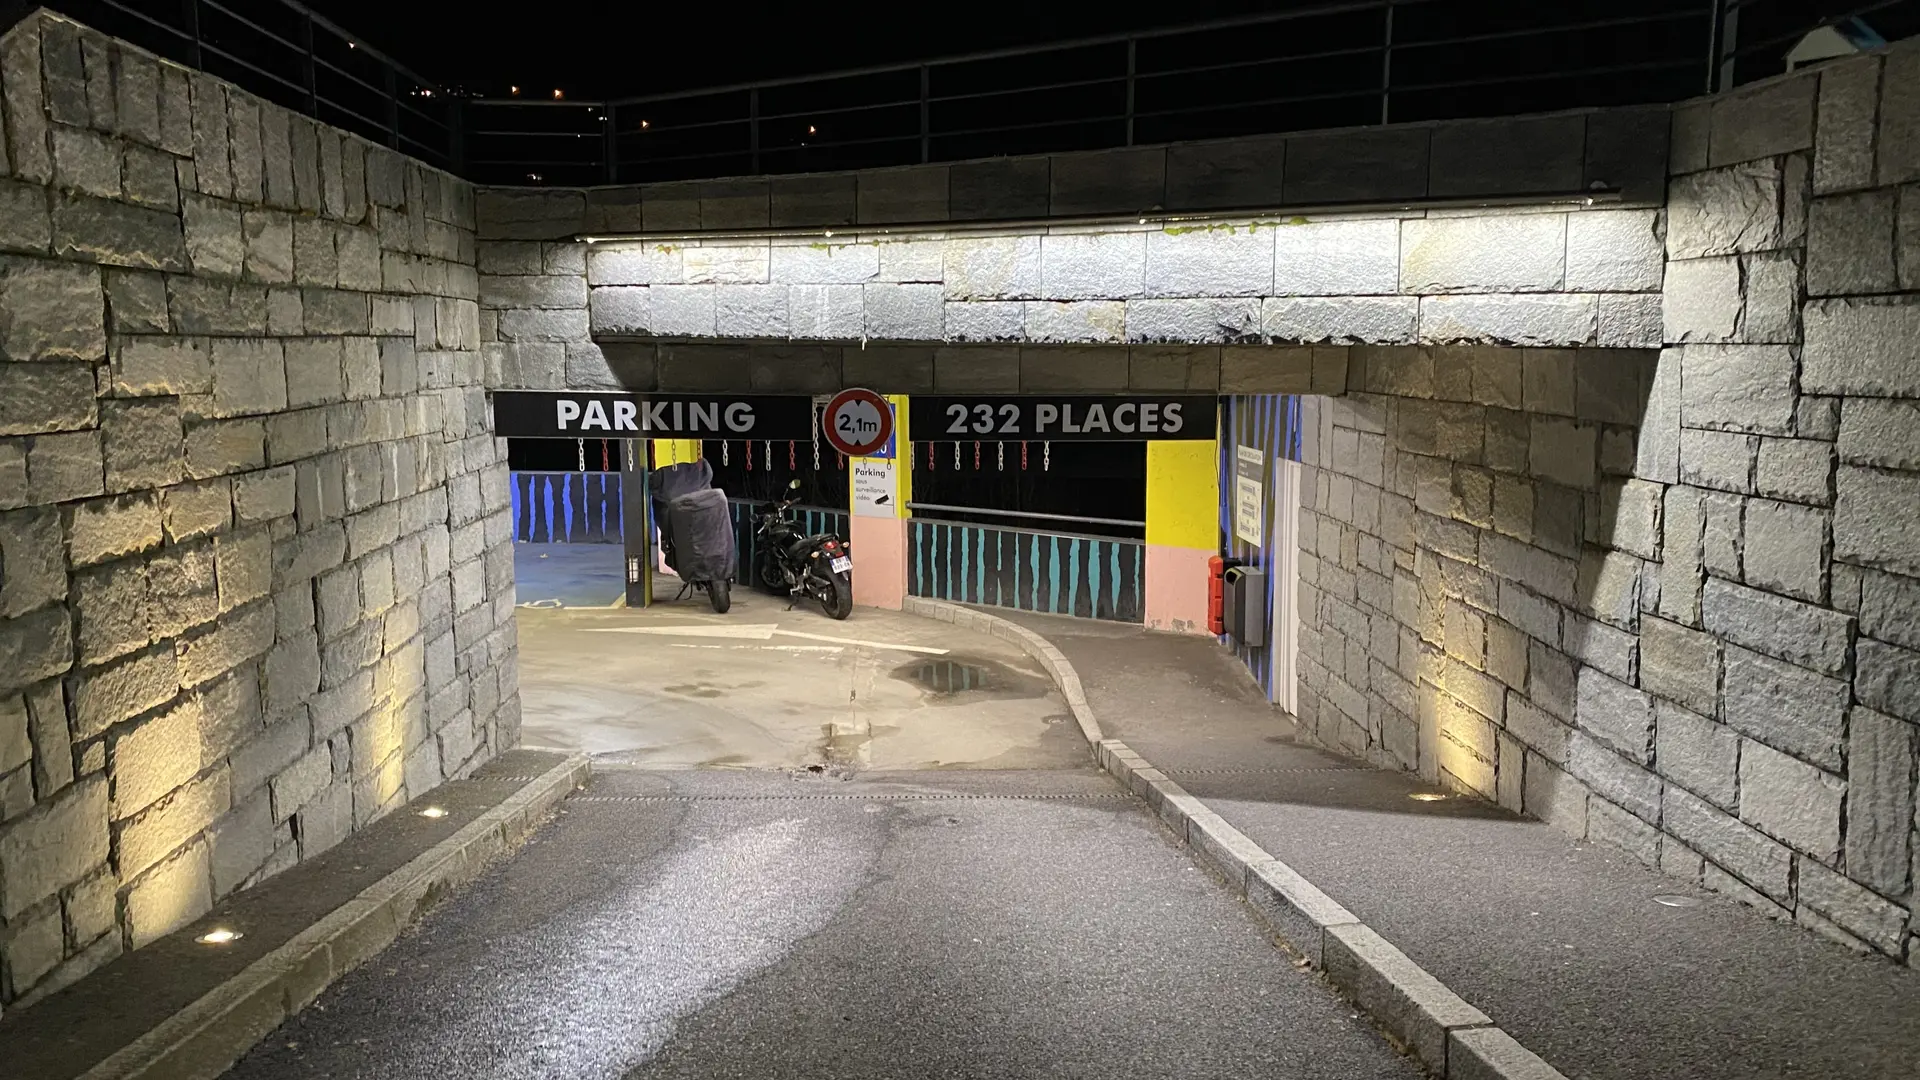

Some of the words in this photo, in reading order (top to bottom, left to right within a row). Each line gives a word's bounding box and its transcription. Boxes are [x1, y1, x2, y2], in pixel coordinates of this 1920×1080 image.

[556, 399, 756, 433] PARKING
[839, 413, 877, 434] 2,1m
[946, 403, 1021, 434] 232
[1035, 402, 1184, 434] PLACES
[855, 467, 886, 479] Parking
